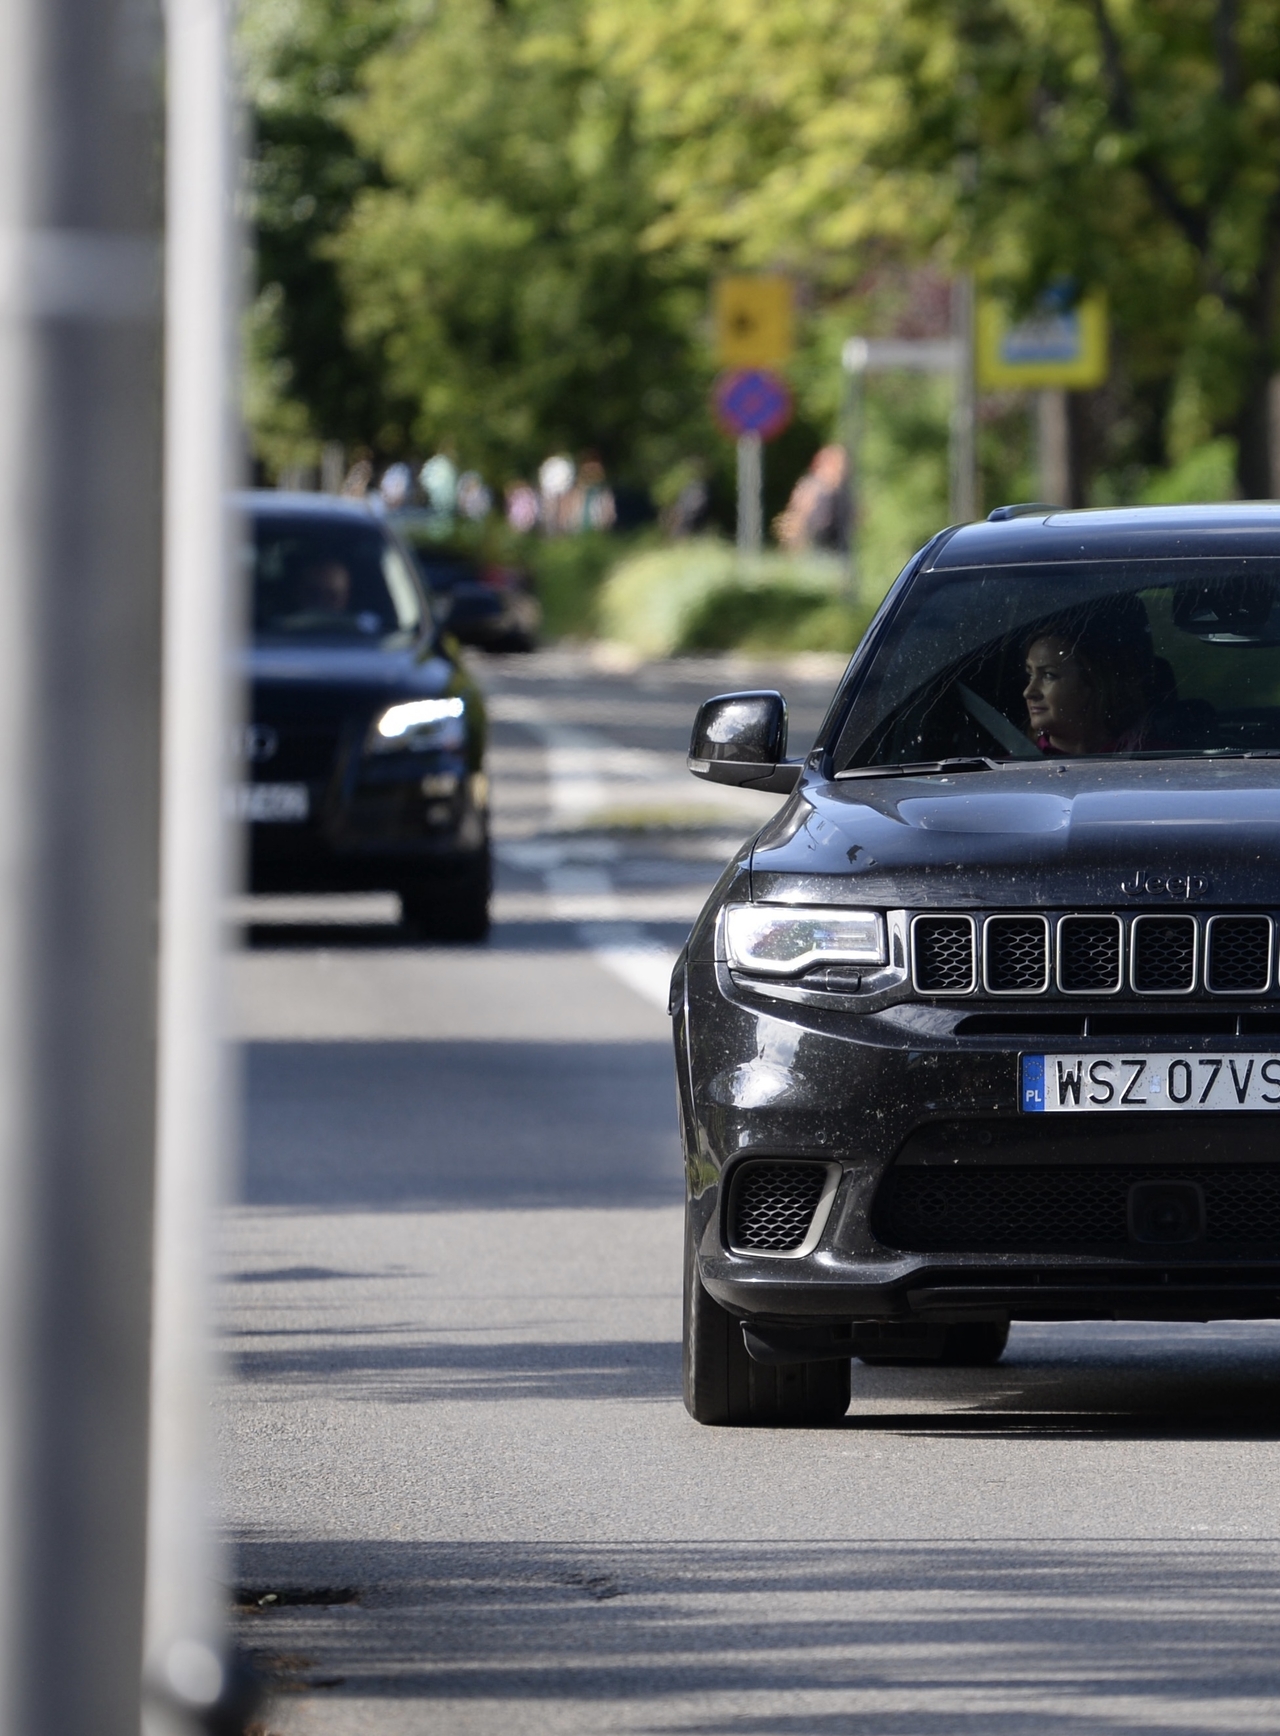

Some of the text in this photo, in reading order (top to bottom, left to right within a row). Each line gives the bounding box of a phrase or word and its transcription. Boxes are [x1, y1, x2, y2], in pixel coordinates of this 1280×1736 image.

[1121, 870, 1209, 898] Jeep
[1025, 1089, 1042, 1102] PL
[1056, 1059, 1148, 1105] WSZ
